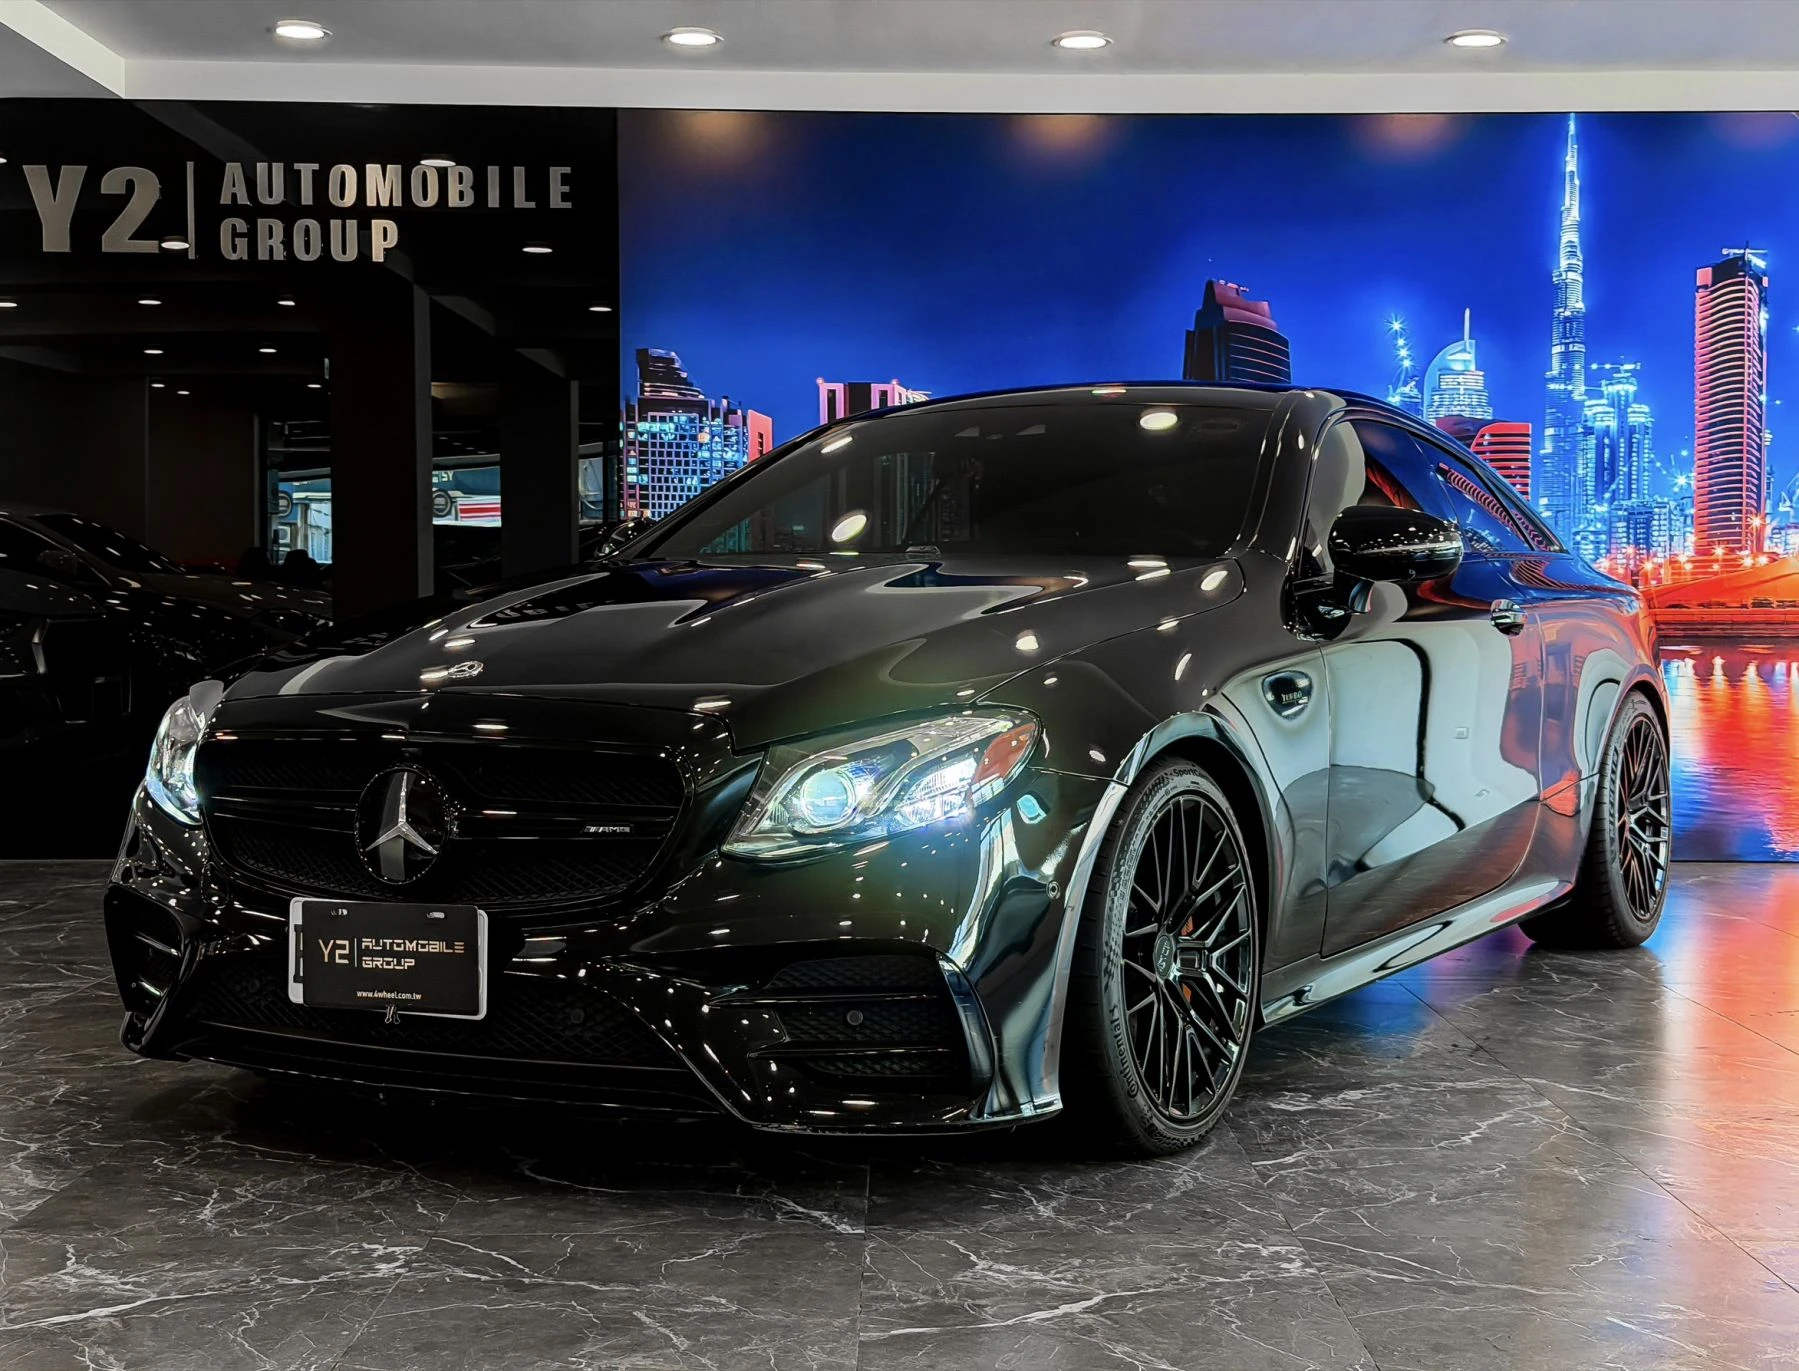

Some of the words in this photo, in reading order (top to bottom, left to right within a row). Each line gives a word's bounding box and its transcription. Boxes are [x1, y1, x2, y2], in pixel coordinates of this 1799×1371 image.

[219, 162, 573, 209] AUTOMOBILE
[22, 165, 161, 253] Y2
[220, 218, 399, 262] GROUP
[318, 939, 350, 964] Y2
[362, 938, 465, 954] AUTOMOBILE
[362, 957, 415, 970] GROUP
[357, 990, 422, 1000] www.4wheel.com.tw
[1110, 1018, 1139, 1098] Continental
